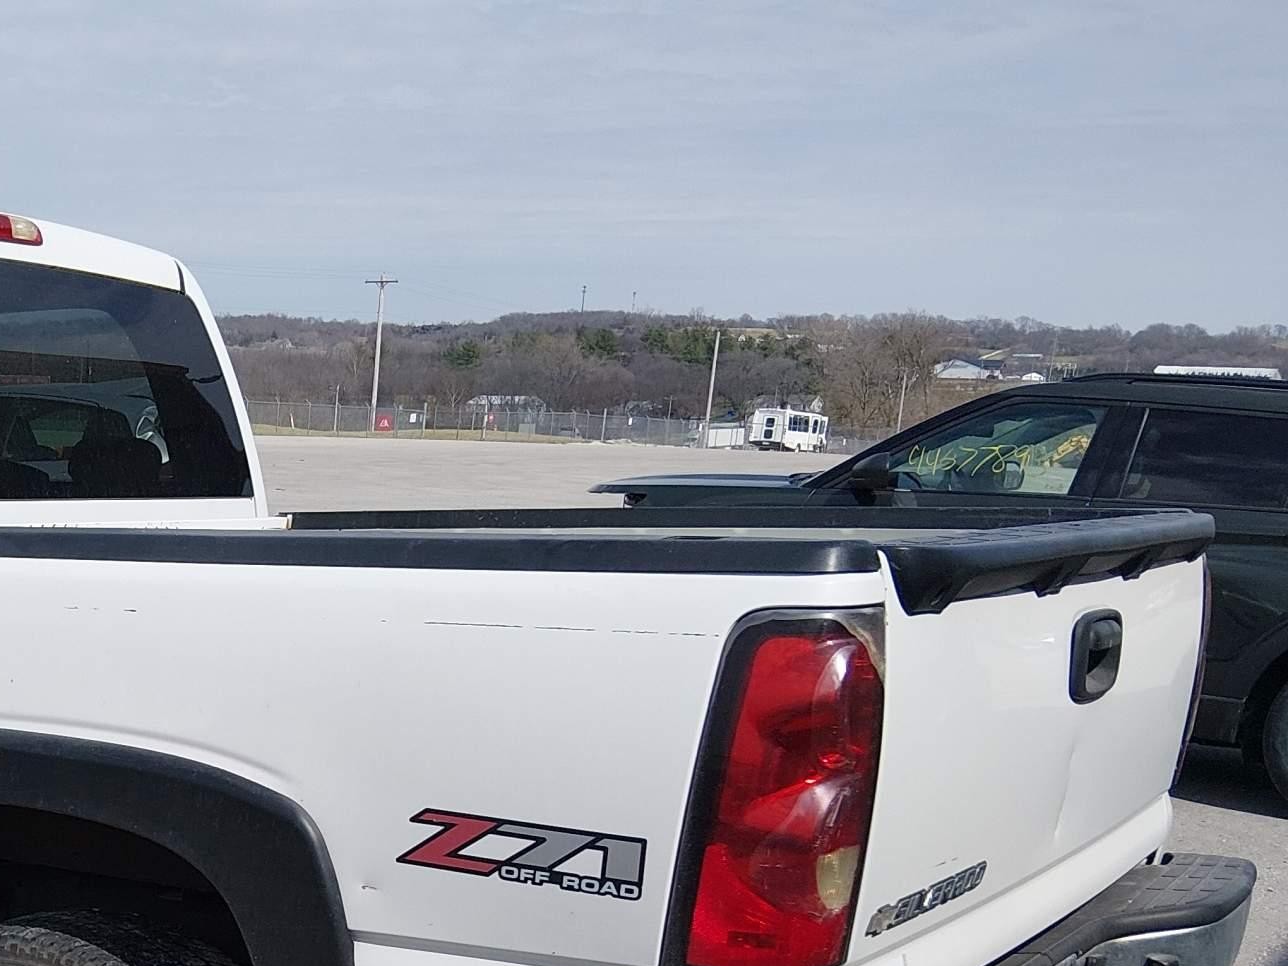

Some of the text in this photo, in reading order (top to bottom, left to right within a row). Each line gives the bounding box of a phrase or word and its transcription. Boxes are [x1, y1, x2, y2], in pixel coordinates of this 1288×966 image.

[396, 808, 647, 883] Z71
[499, 864, 642, 900] OFF ROAD
